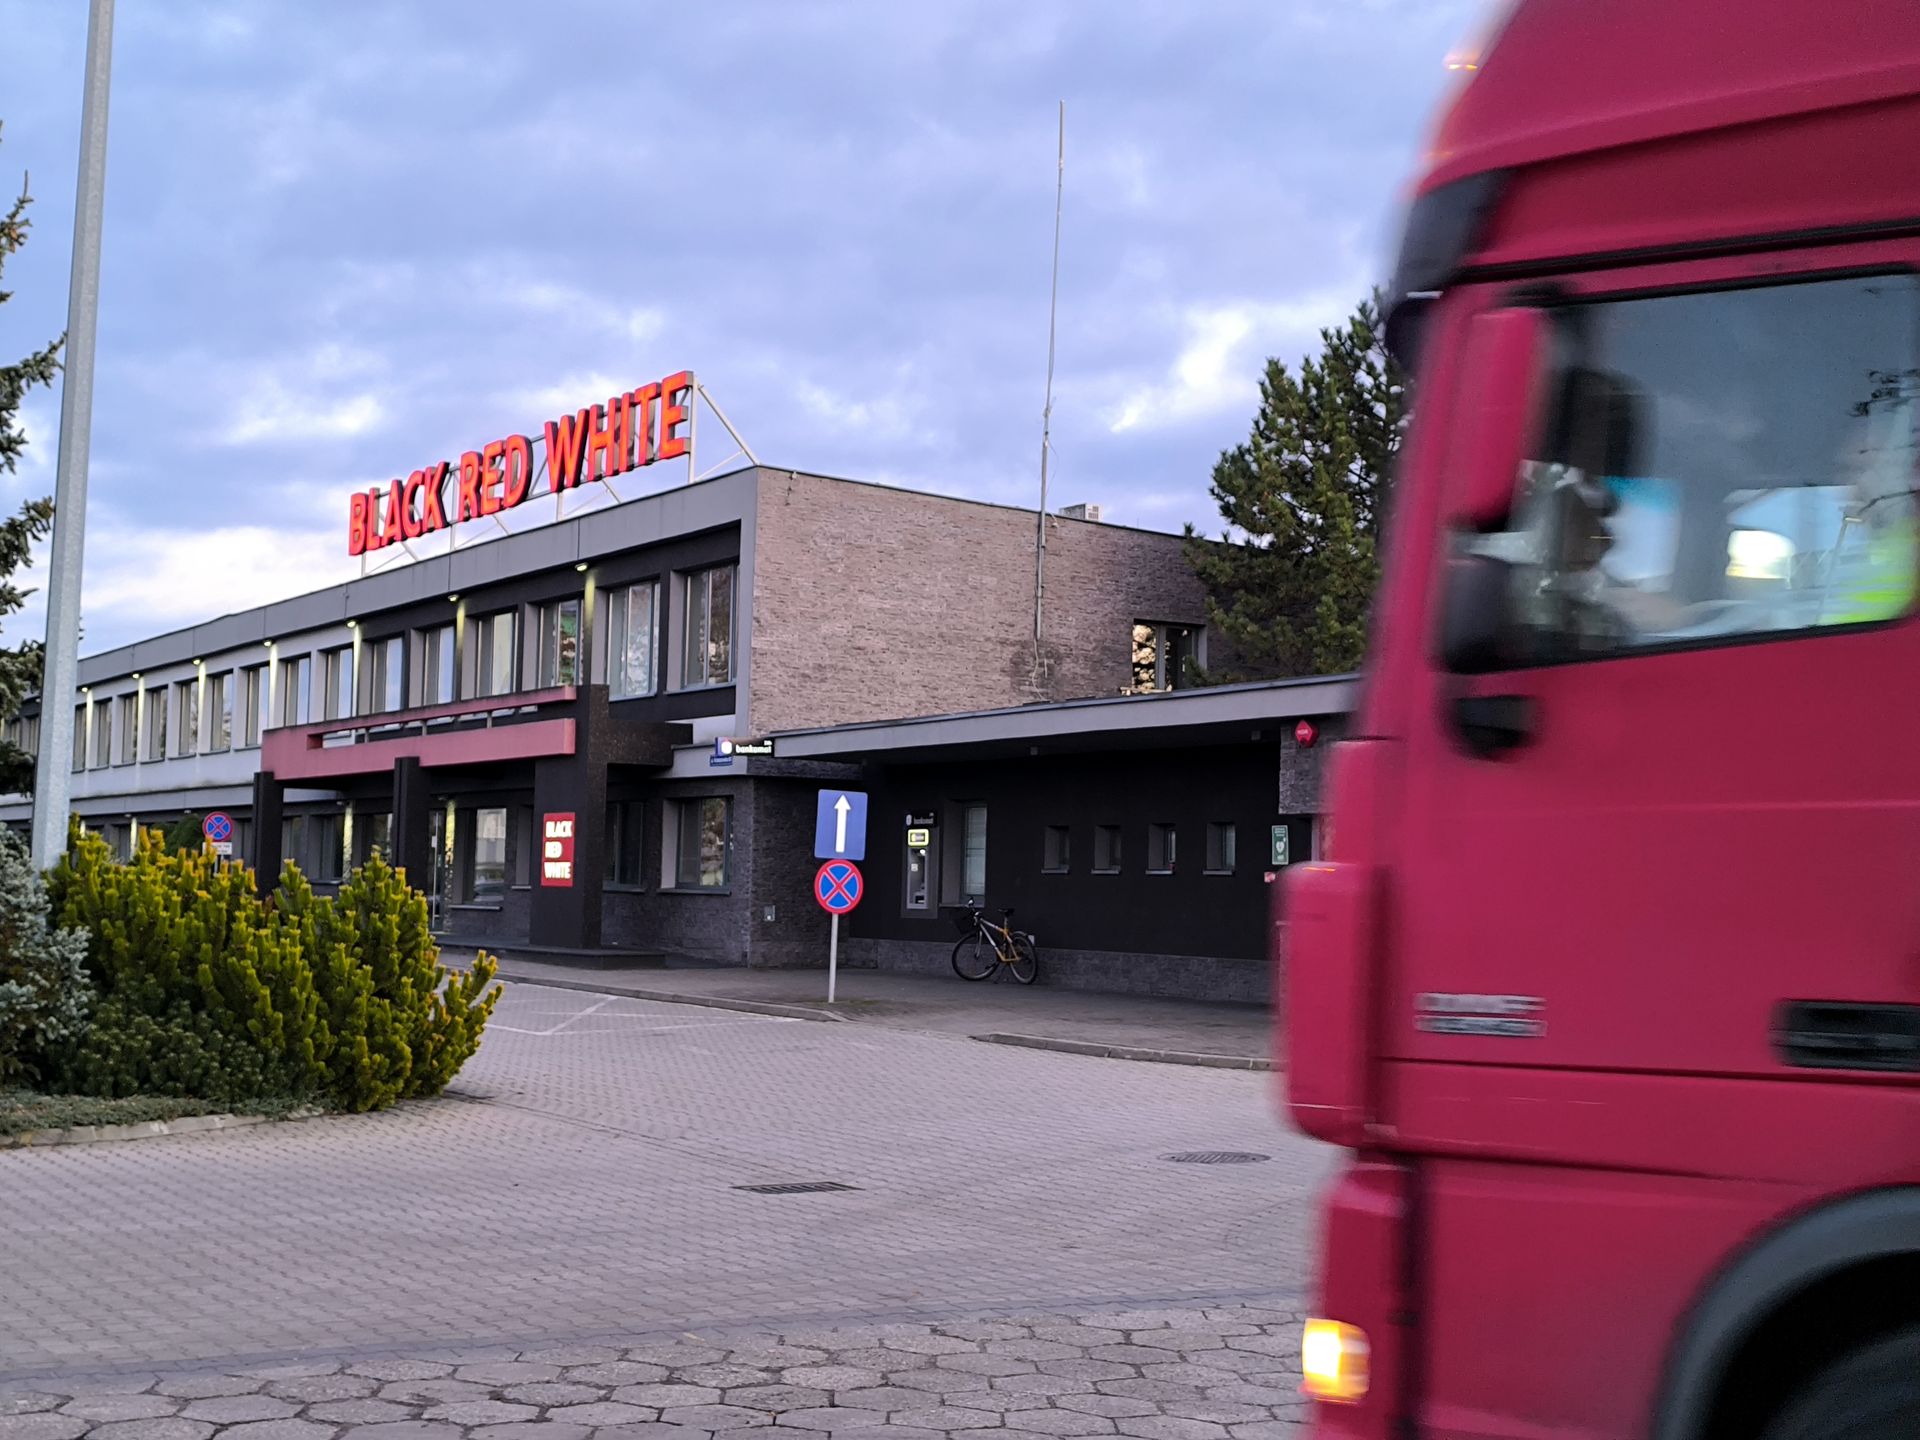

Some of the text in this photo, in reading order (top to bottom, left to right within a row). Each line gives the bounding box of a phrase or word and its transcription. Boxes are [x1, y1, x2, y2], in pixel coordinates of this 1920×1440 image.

[349, 370, 693, 556] BLACK RED WHITE
[546, 820, 573, 838] BLACK
[544, 861, 571, 879] WHITE
